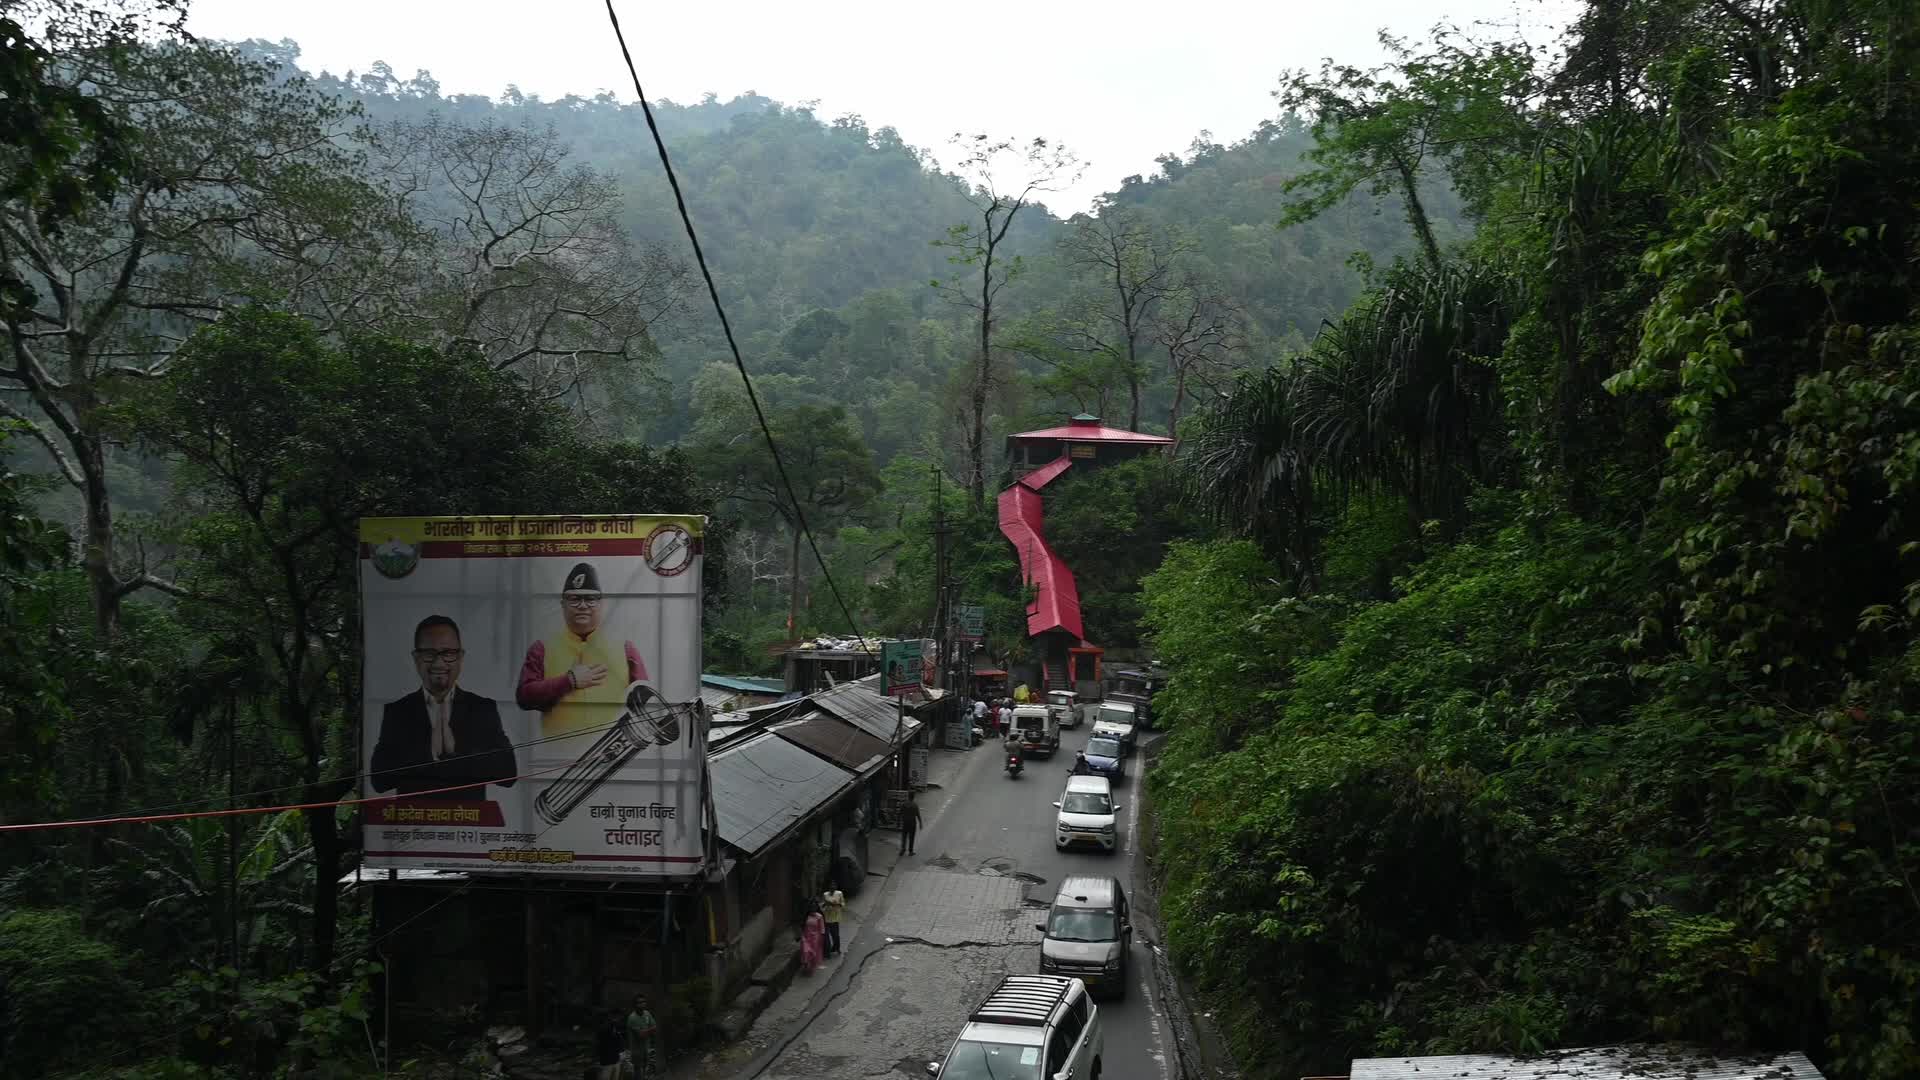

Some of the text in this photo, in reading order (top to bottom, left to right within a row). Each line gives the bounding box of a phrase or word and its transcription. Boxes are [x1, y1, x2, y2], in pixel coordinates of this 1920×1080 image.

[424, 515, 633, 537] भारतीय गोर्खा प्रजातान्त्रिक मोर्चा
[589, 802, 677, 823] हाम्रो चुनाव चिन्ह
[457, 831, 478, 843] (२२)
[604, 824, 663, 847] टर्चलाइट
